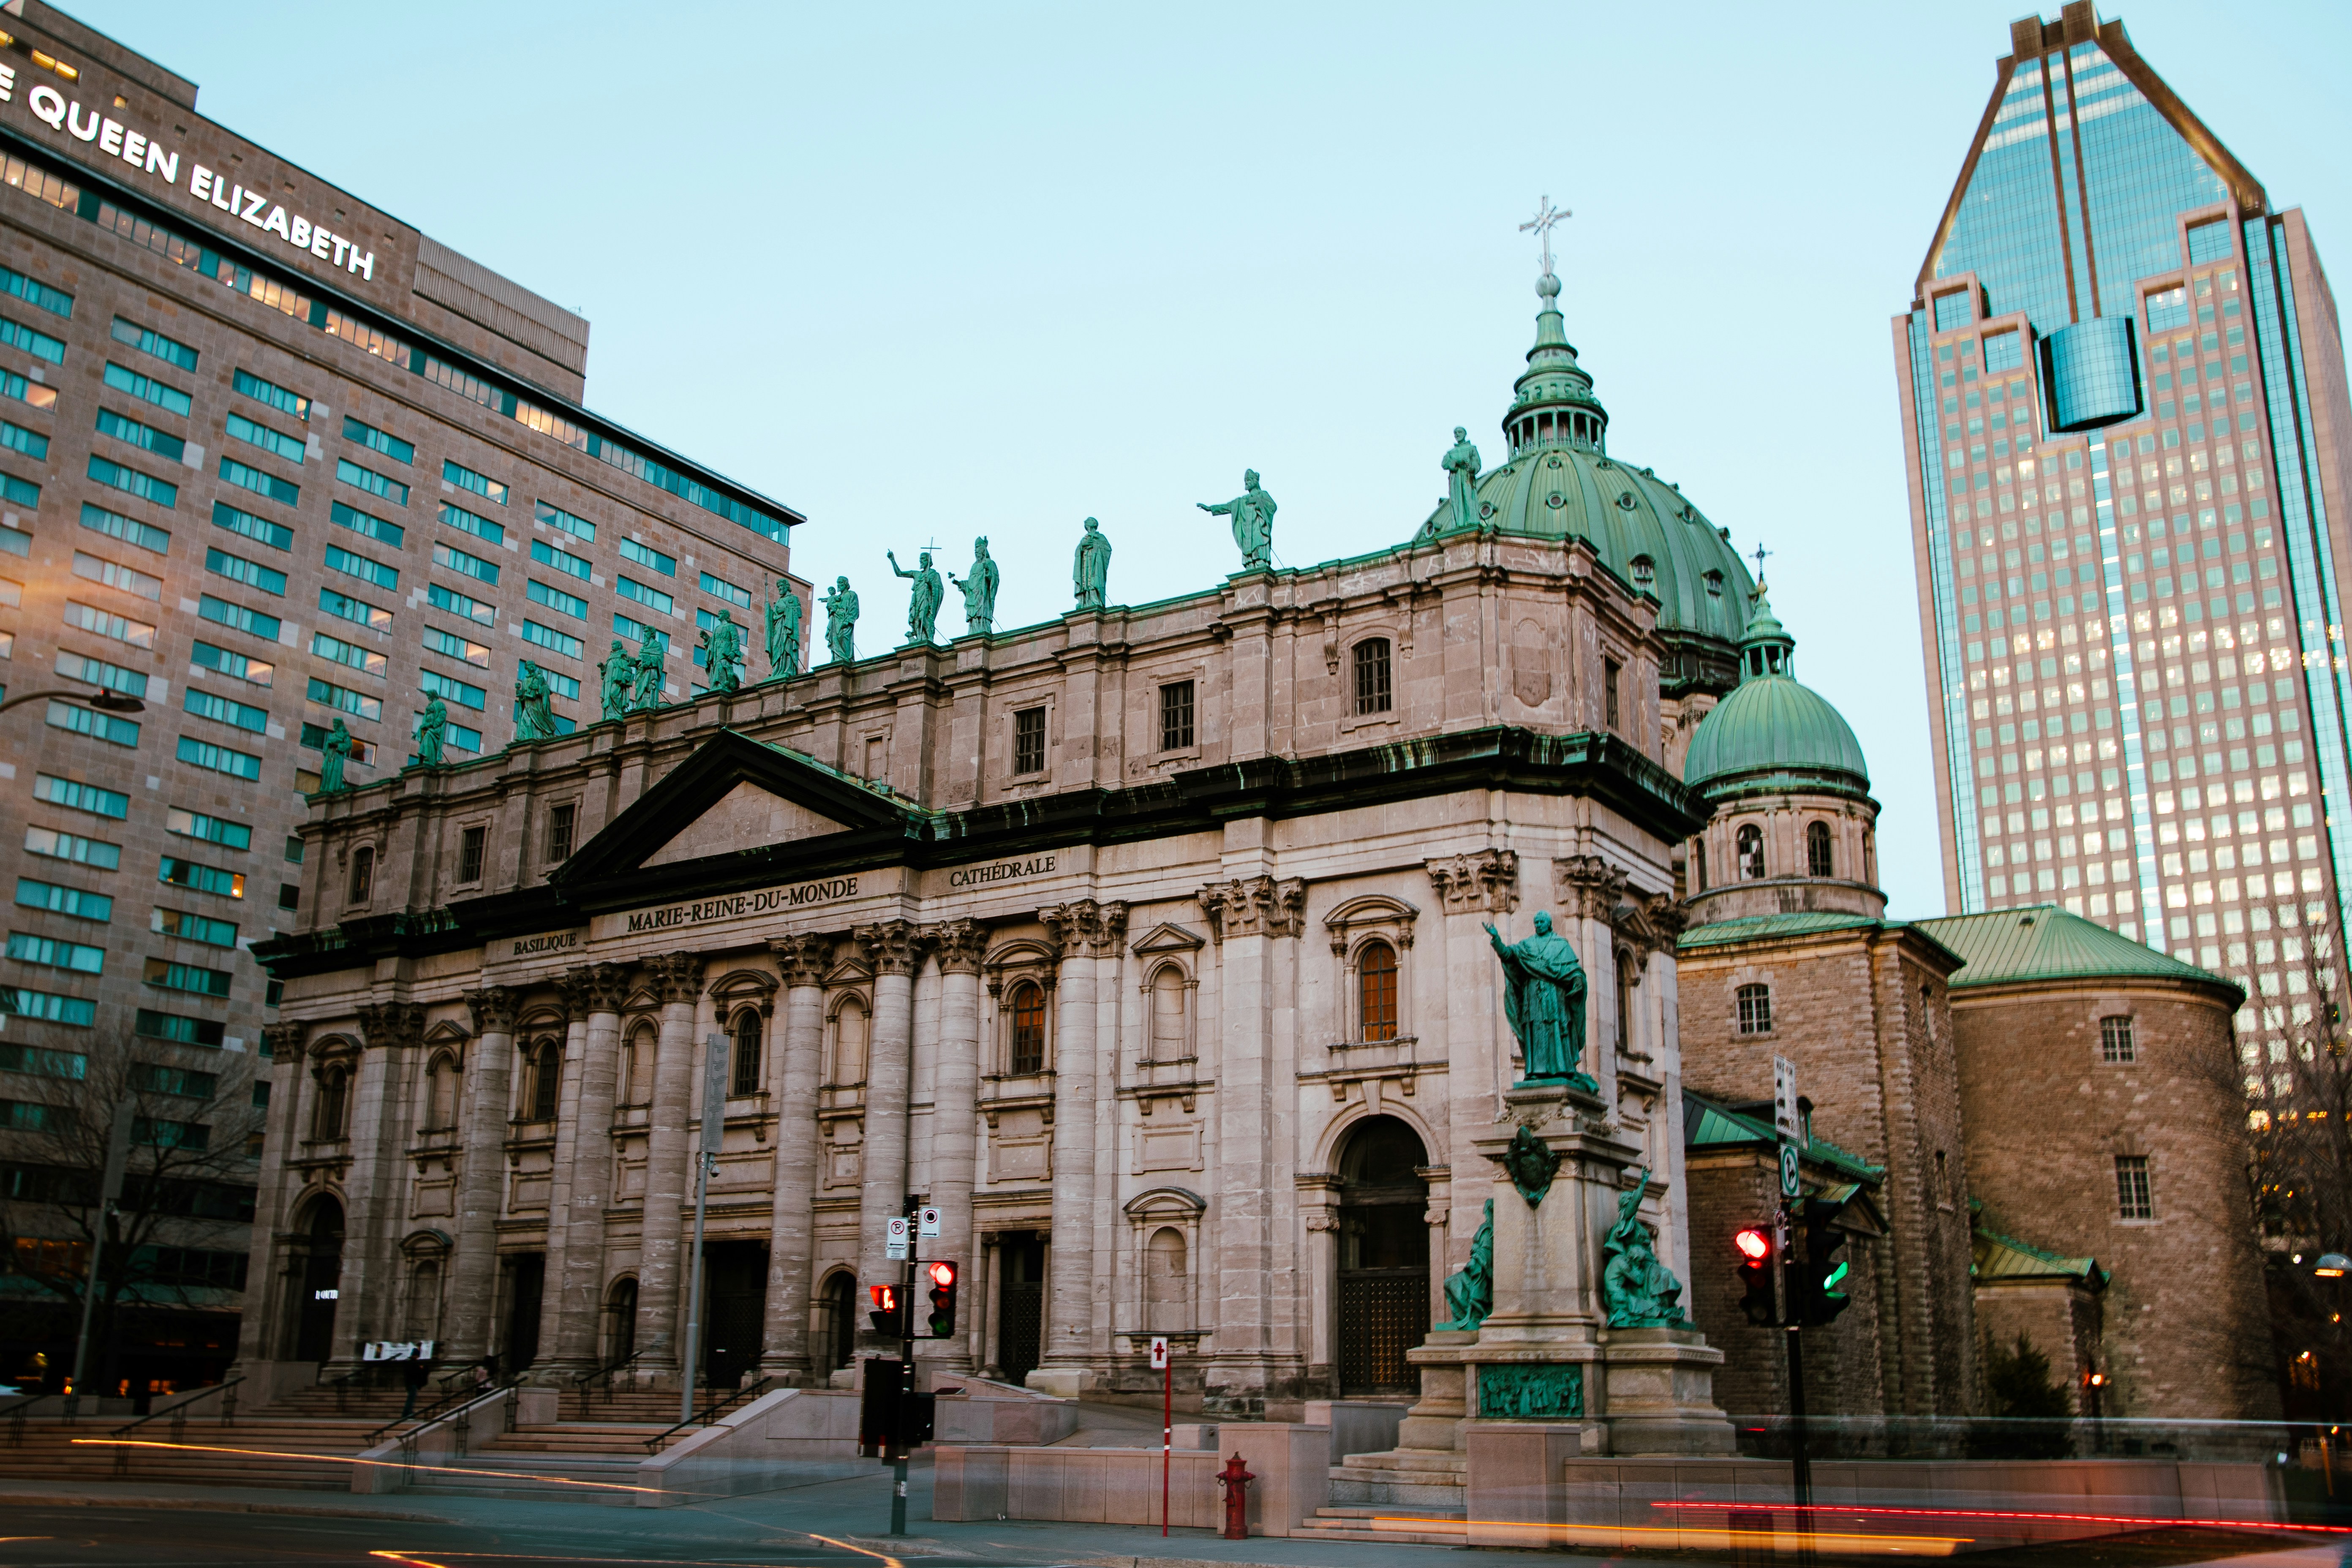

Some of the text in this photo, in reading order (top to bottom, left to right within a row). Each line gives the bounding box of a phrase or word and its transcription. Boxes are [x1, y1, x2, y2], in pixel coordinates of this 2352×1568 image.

[29, 86, 179, 184] QUEEN
[190, 164, 374, 281] ELIZABETH
[950, 856, 1056, 887] CATHÉDRALE
[627, 877, 858, 932] MARIE-REINE-DU-MONDE
[514, 933, 577, 955] BASILIQUE
